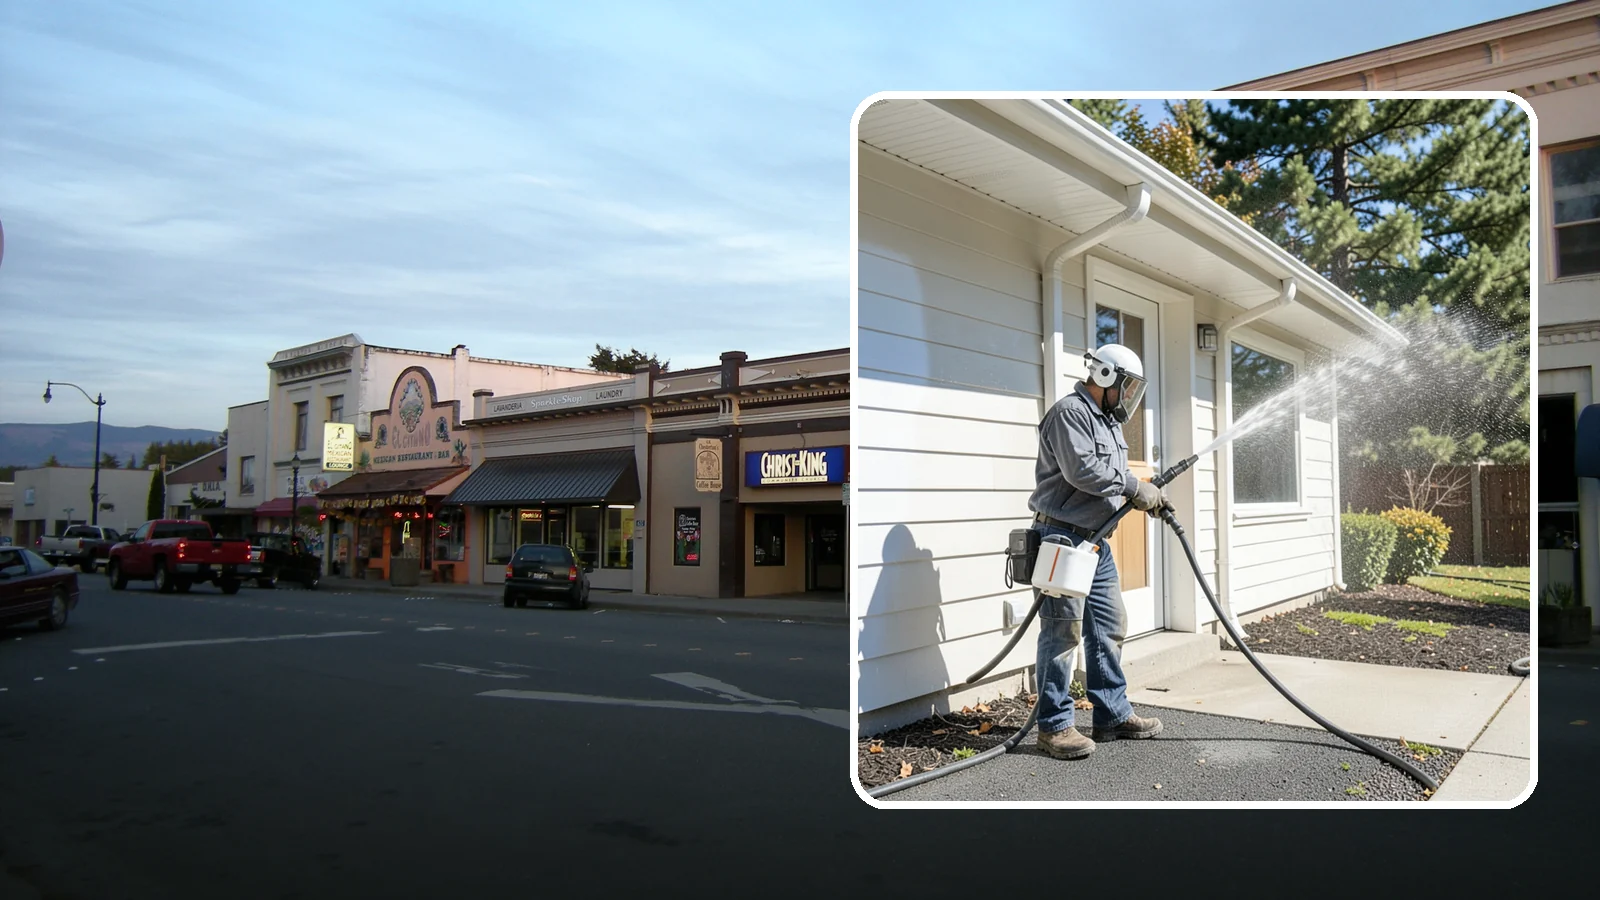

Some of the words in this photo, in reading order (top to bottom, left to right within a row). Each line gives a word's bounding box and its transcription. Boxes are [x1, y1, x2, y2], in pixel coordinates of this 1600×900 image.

[493, 402, 523, 412] LAVANDERIA
[595, 389, 624, 399] LAUNDRY
[392, 426, 401, 449] EL
[374, 455, 396, 464] MEXICAN
[397, 451, 433, 462] RESTAURANT
[438, 450, 450, 459] BAR
[696, 480, 709, 488] Coffee
[710, 480, 722, 488] House
